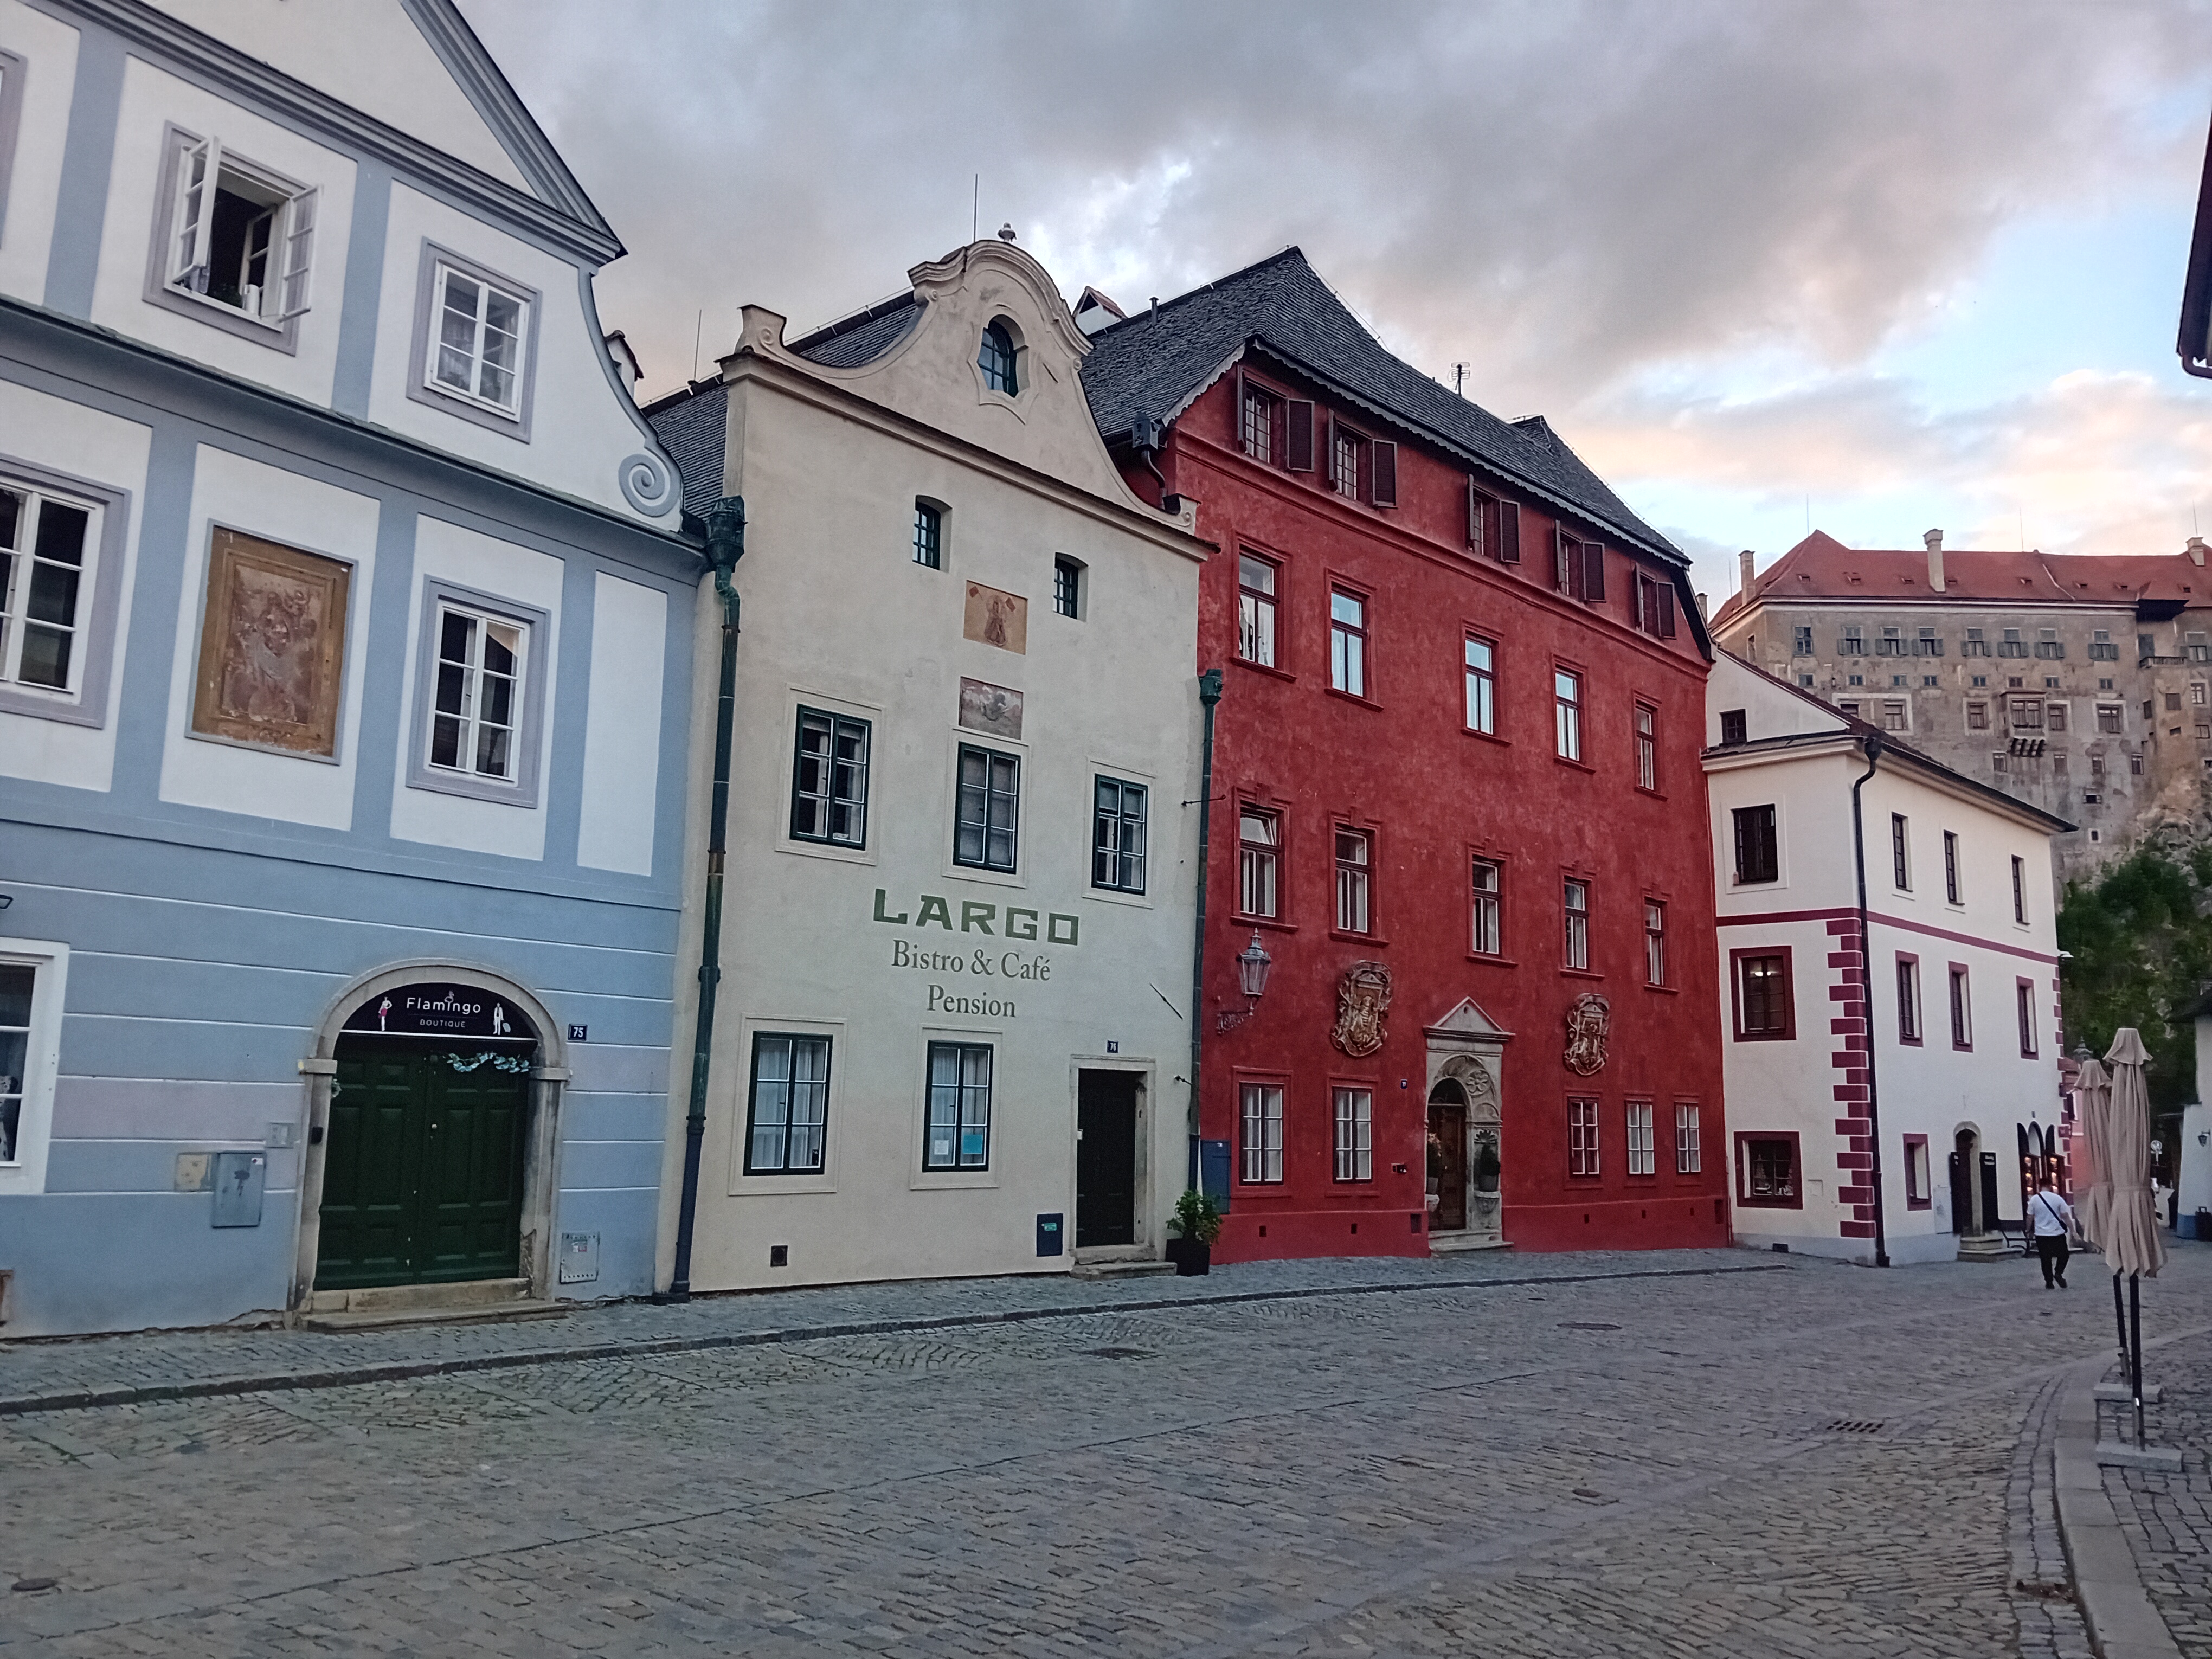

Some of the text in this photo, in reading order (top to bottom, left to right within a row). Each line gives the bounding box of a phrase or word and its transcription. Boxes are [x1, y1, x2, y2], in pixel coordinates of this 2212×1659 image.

[873, 888, 1079, 946] LARGO
[891, 940, 1051, 981] Bistro & Café
[406, 996, 481, 1015] Flamingo
[927, 985, 1017, 1018] Pension
[420, 1019, 466, 1028] BOUTIQUE
[573, 1027, 584, 1038] 75
